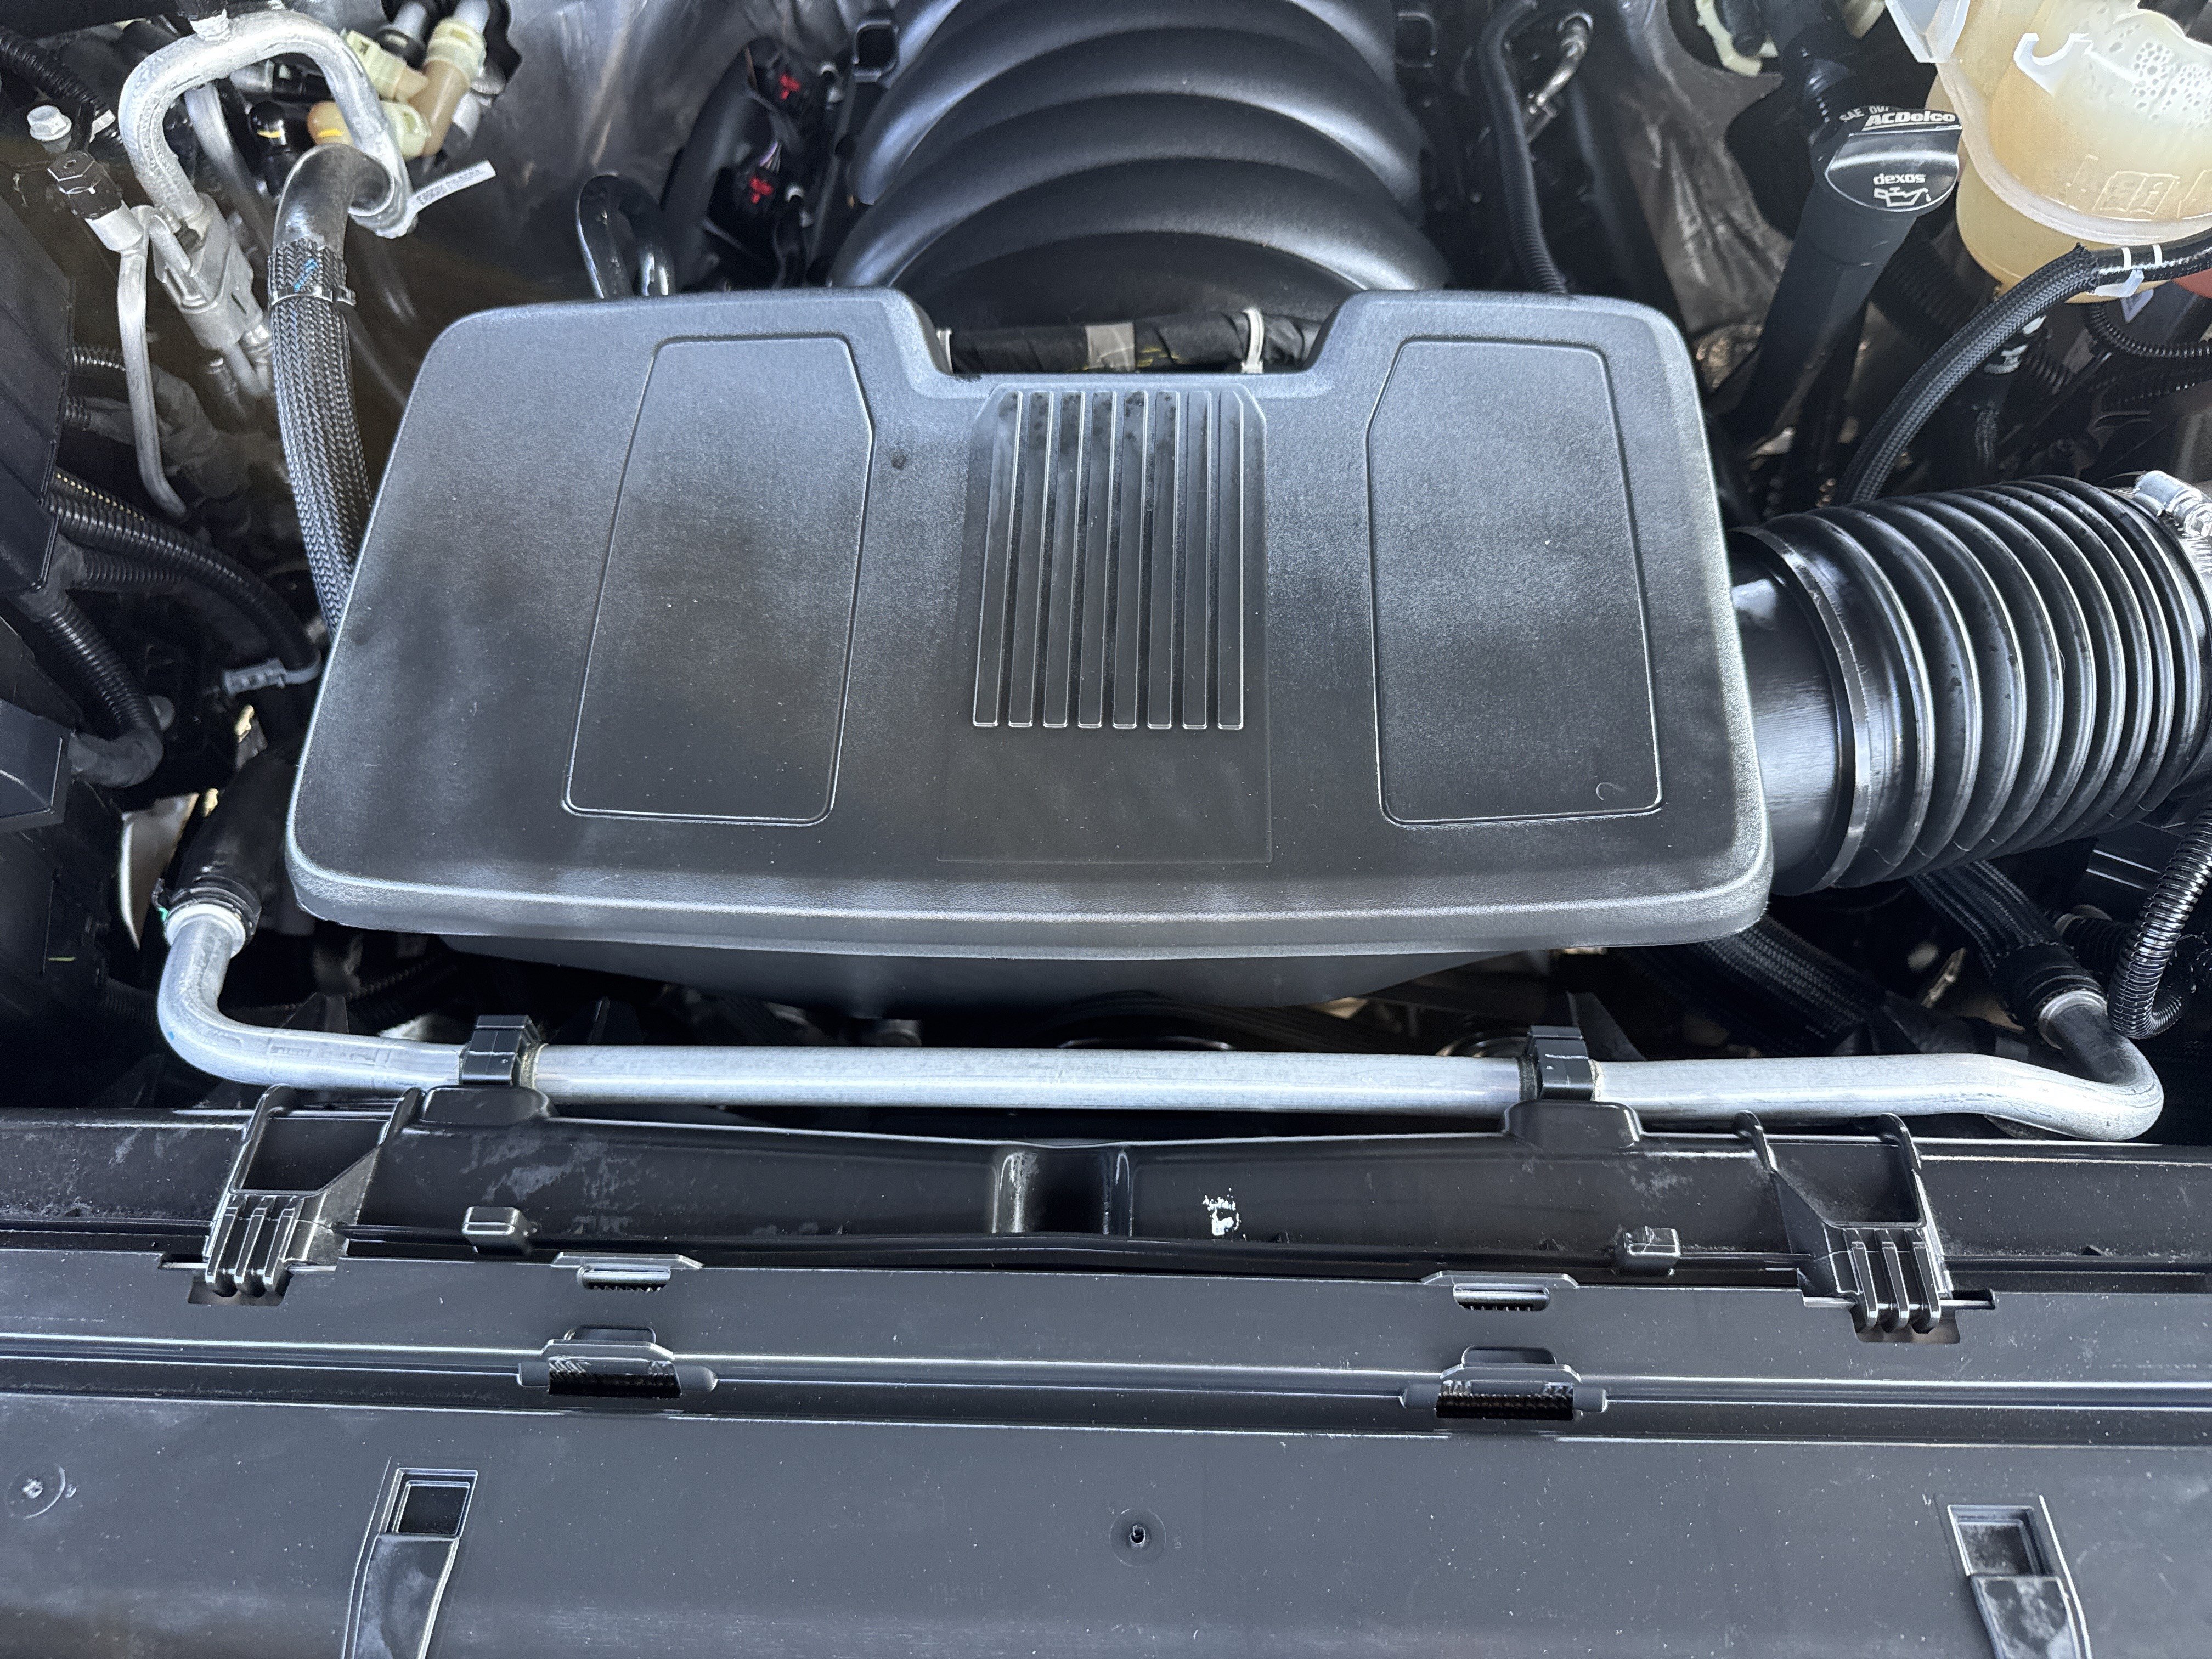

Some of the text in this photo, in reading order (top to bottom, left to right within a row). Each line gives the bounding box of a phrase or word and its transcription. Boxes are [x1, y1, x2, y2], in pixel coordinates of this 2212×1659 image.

[1839, 108, 1865, 122] SAE
[1864, 111, 1956, 127] ACDelco
[1873, 173, 1926, 185] dexos
